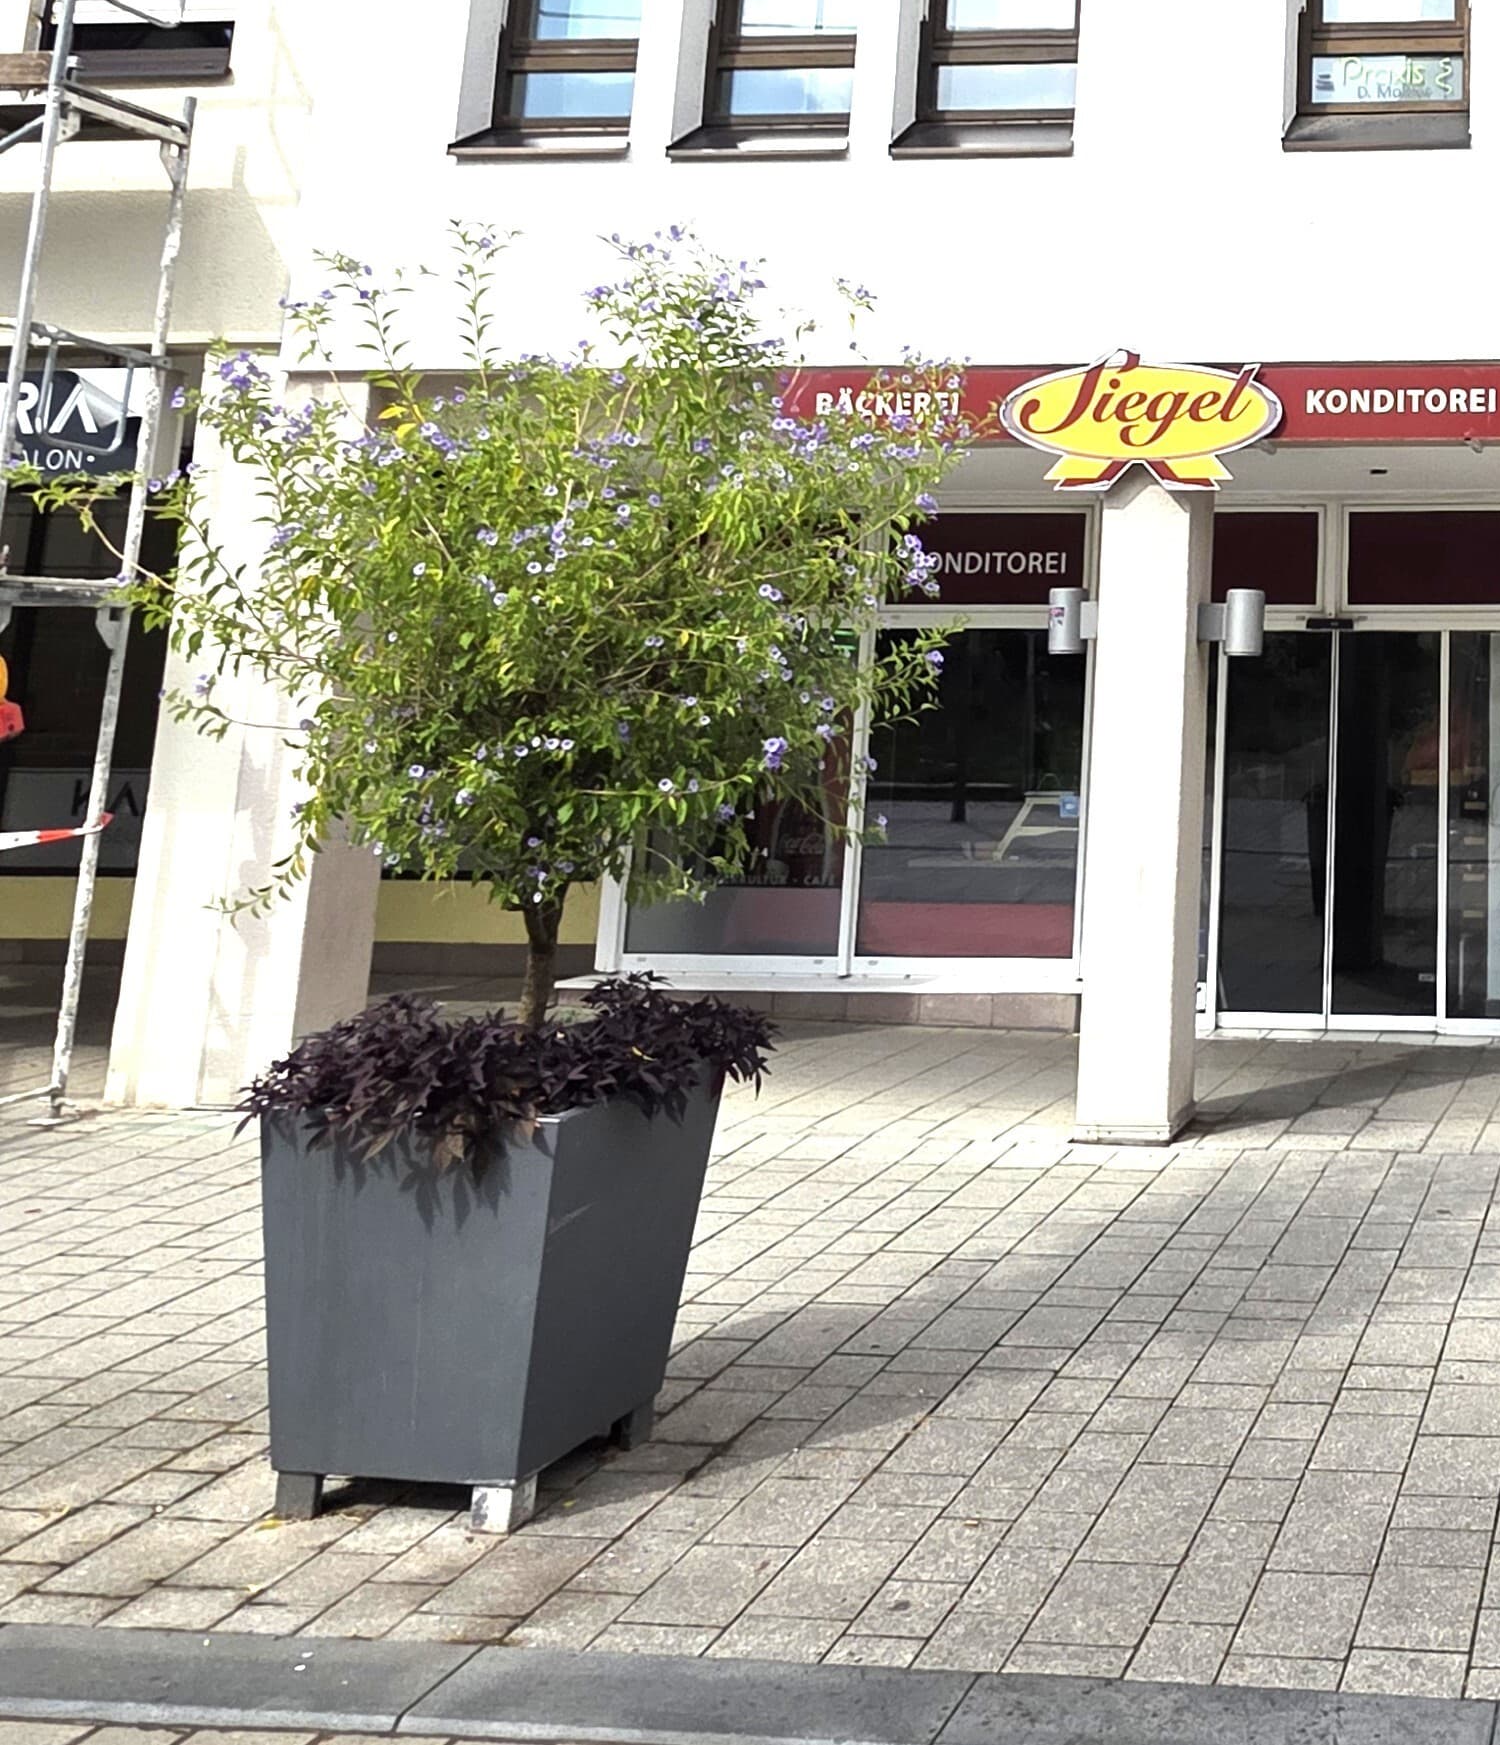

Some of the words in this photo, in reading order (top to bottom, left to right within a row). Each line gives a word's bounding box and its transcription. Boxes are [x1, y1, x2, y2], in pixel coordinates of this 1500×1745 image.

[1341, 56, 1425, 86] Praxis
[815, 387, 960, 416] BÄCKEREI
[1019, 349, 1258, 447] Siegel
[1304, 387, 1498, 415] KONDITOREI
[928, 552, 1068, 575] ONDITOREI
